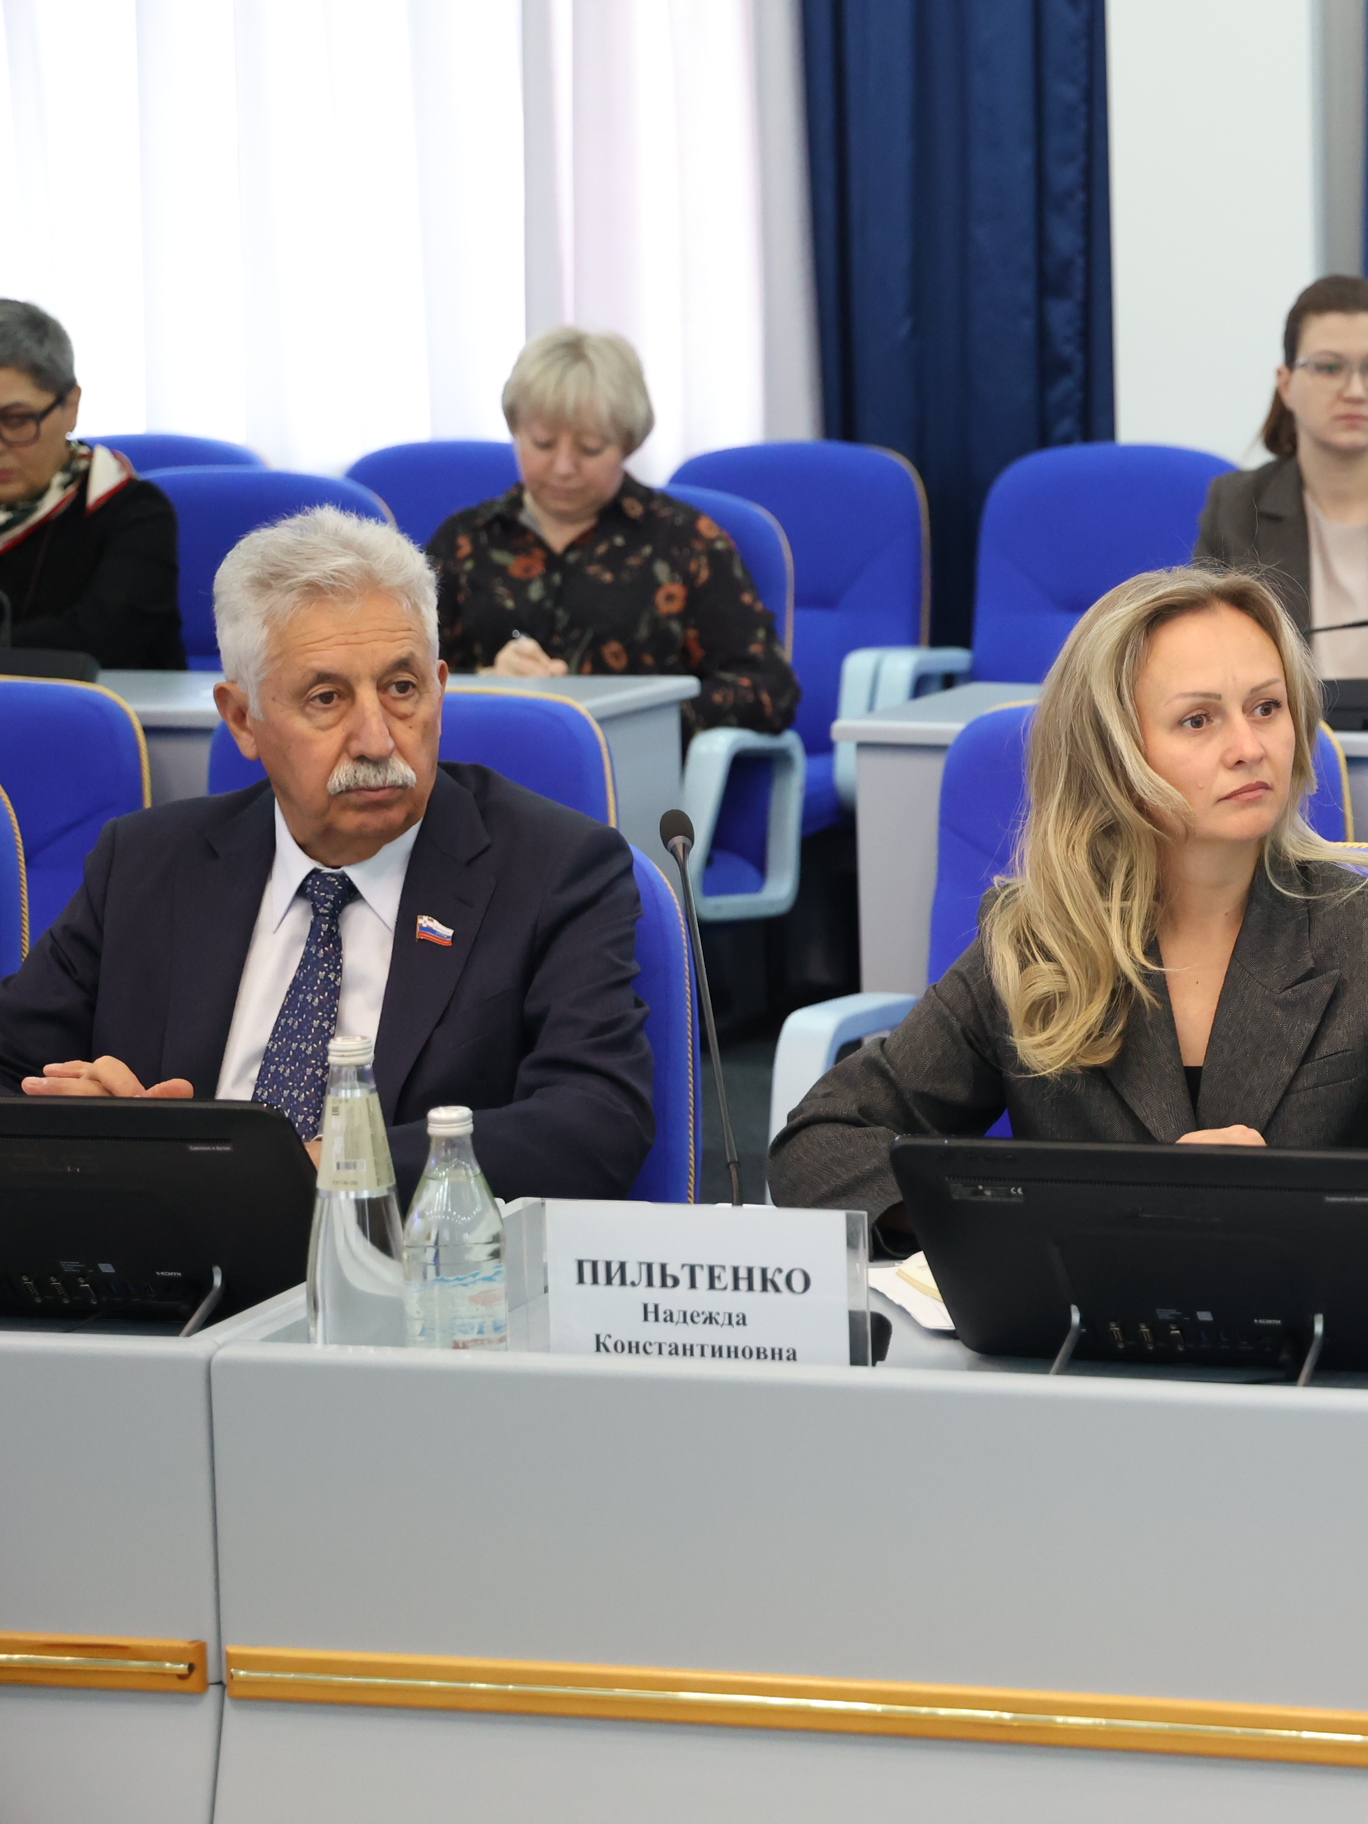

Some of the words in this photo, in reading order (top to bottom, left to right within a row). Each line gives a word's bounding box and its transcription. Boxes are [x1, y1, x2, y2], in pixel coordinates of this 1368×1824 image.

[576, 1258, 812, 1295] ПИЛЬТЕНКО
[642, 1302, 748, 1328] Надежда
[594, 1333, 798, 1362] Константиновна
